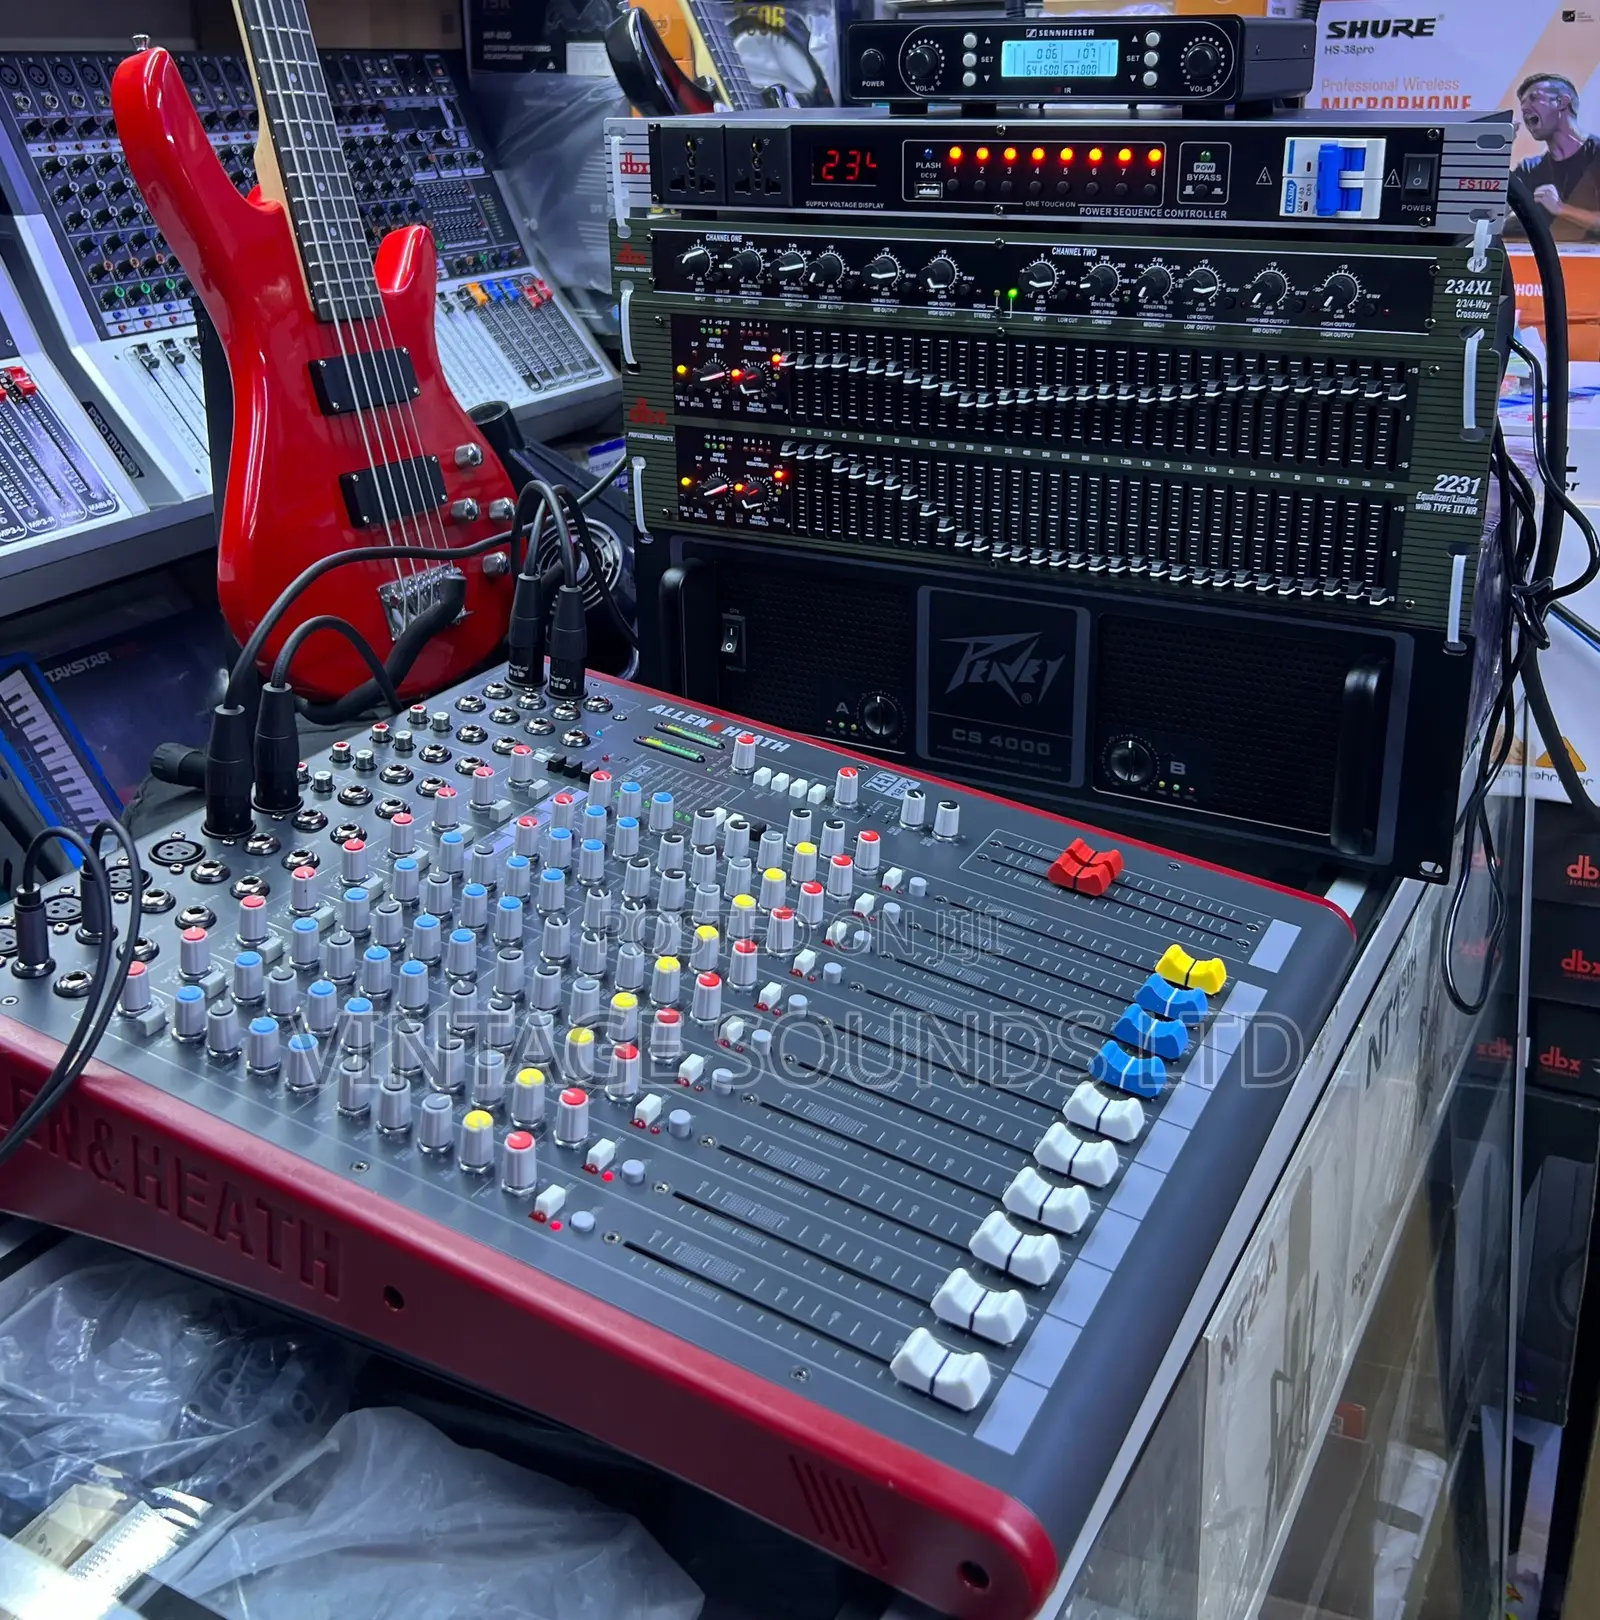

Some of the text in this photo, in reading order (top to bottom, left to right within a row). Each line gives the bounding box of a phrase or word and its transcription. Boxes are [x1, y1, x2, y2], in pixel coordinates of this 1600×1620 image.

[1038, 28, 1095, 37] SENNHEISER
[1325, 17, 1437, 39] SHURE
[1324, 45, 1375, 56] HS-38pro
[1321, 77, 1460, 92] Professional Wireless
[1091, 168, 1097, 176] 6
[1121, 168, 1127, 176] 7
[1150, 169, 1156, 177] 8
[1458, 178, 1501, 191] FS102
[1079, 207, 1227, 219] POWER SEQUENCE CONTROLLER
[1401, 204, 1432, 212] POWER
[705, 234, 743, 243] CHANNEL ONE
[1052, 247, 1097, 257] CHANNEL TWO
[1444, 279, 1493, 296] 234XL
[1456, 299, 1491, 311] 2/3/4-Way
[1456, 309, 1490, 320] Crossover
[87, 405, 142, 478] PRO MIXER
[1433, 474, 1482, 495] 2231
[1415, 491, 1479, 505] Equalizer/Limiter
[1415, 502, 1478, 515] with TYPE III NR
[43, 651, 112, 683] TAKSTAR
[939, 631, 1067, 707] PEAVEY
[836, 702, 850, 715] A
[647, 704, 713, 729] ALLEN
[952, 728, 1051, 756] CS 4000
[1170, 760, 1186, 775] B
[867, 772, 898, 793] ZED
[1567, 855, 1600, 879] db
[1539, 1046, 1582, 1071] dbx
